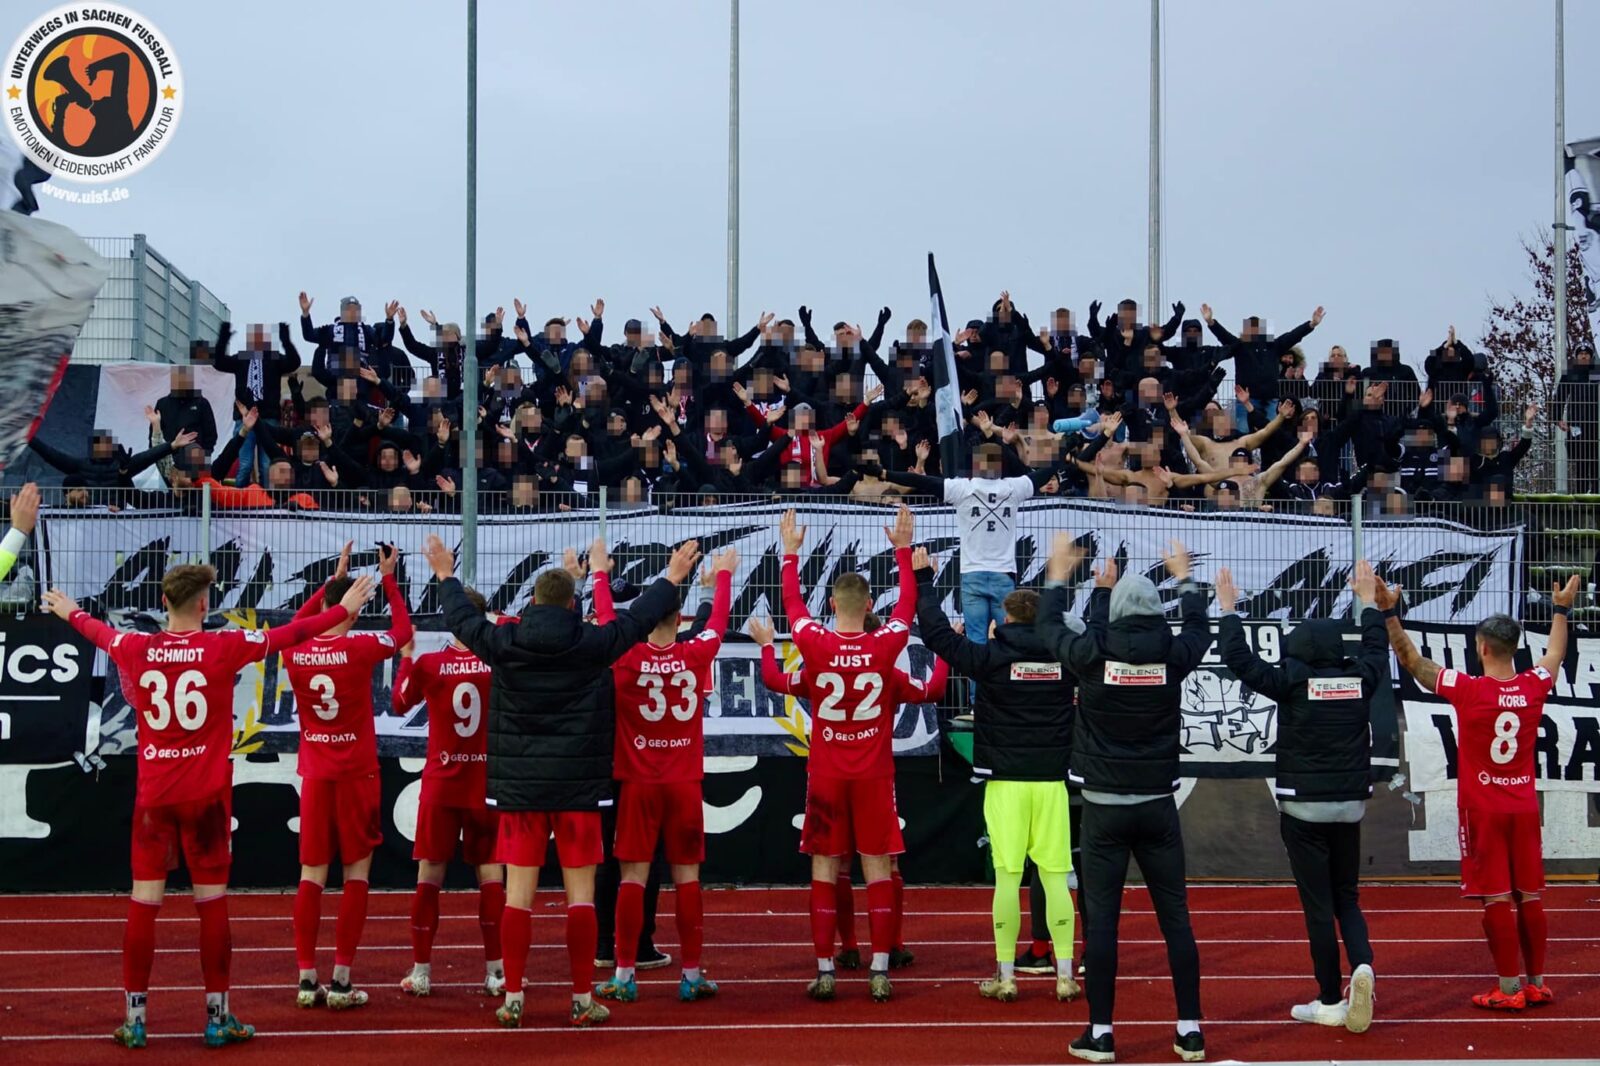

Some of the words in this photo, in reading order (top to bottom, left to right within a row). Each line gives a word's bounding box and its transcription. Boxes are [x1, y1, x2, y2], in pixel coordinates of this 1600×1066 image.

[147, 647, 204, 663] SCHMIDT
[293, 651, 348, 666] HECKMANN
[829, 654, 872, 668] JUST
[439, 660, 492, 675] ARCALEAN
[640, 660, 686, 674] BAGCI
[1018, 665, 1060, 673] TELENOT
[1114, 667, 1165, 675] TELENOT
[1316, 682, 1361, 690] TELENOT
[139, 669, 208, 731] 36
[309, 674, 340, 721] 3
[636, 669, 698, 722] 33
[815, 672, 883, 721] 22
[1498, 694, 1528, 708] KORB
[452, 681, 482, 738] 9
[312, 734, 330, 743] GEO
[331, 733, 357, 743] DATA
[648, 739, 668, 748] GEO
[835, 732, 855, 741] GEO
[1489, 711, 1521, 765] 8
[158, 750, 180, 759] GEO
[451, 753, 469, 762] GEO
[471, 753, 488, 762] DAT
